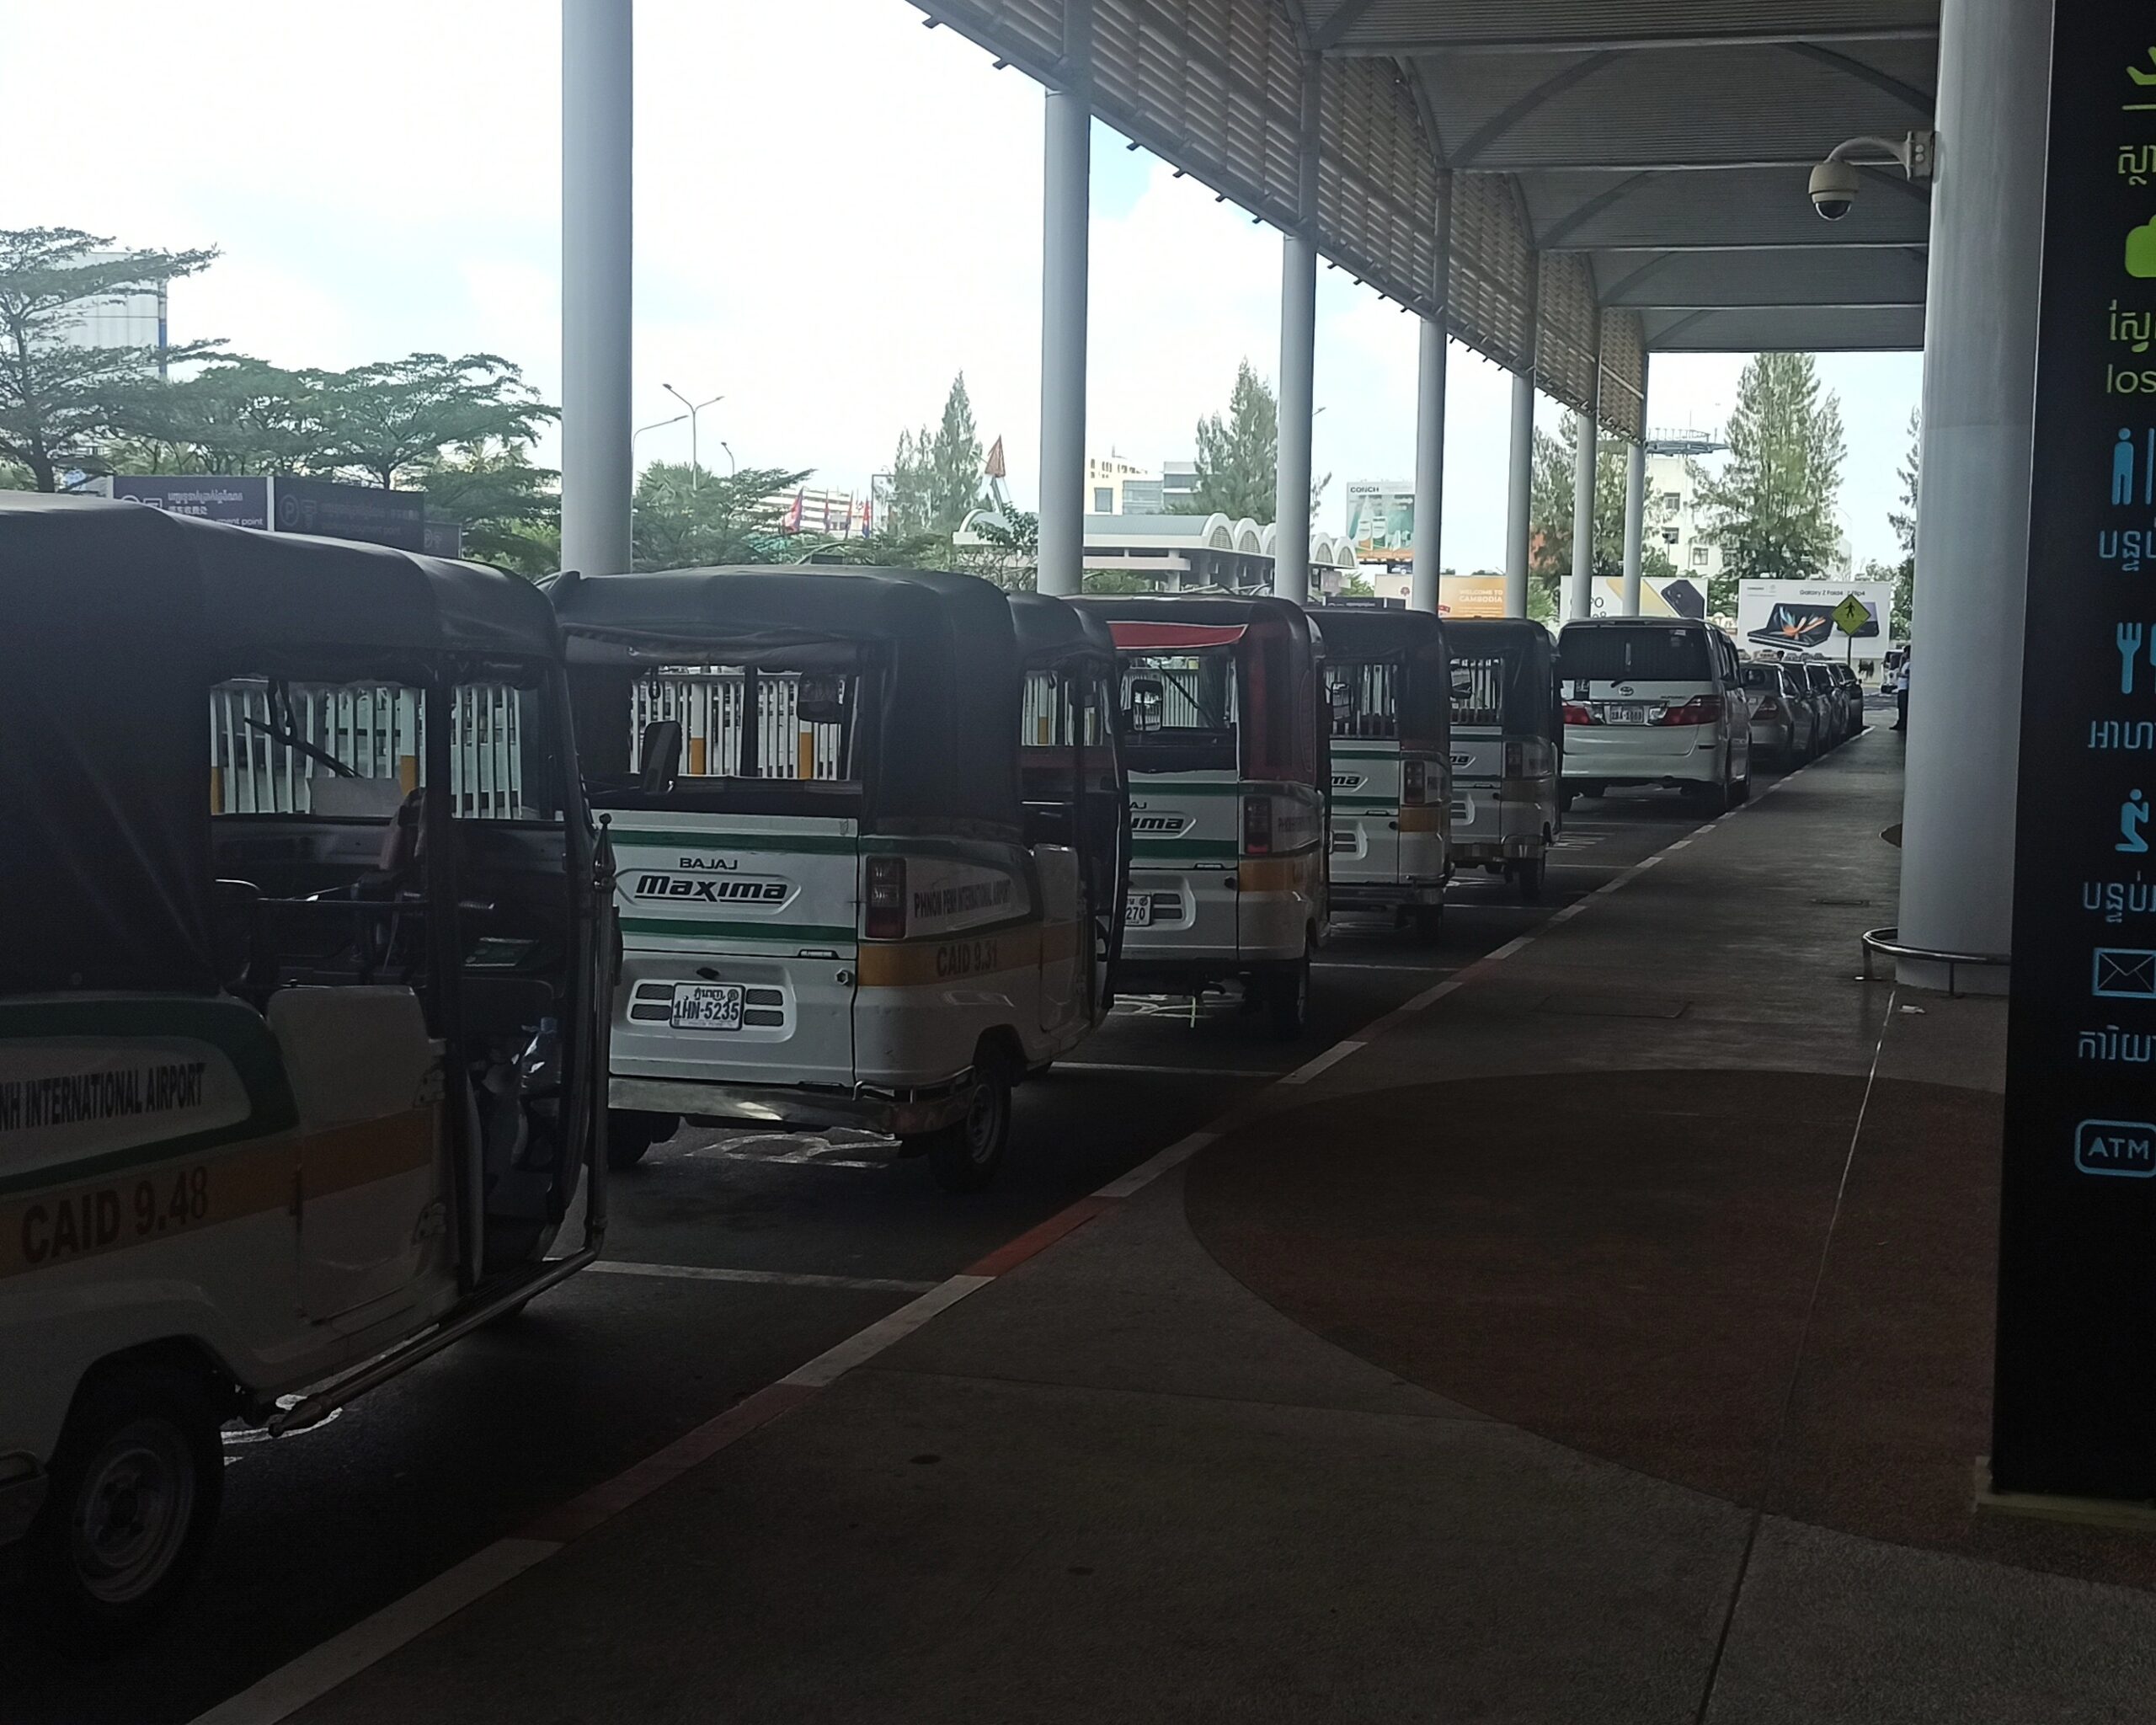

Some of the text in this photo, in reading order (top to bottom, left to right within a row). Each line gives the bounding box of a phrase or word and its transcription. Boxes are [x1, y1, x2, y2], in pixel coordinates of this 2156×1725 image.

[680, 857, 738, 870] BAJAJ
[937, 943, 969, 977] CAID
[25, 1069, 141, 1129] INTERNATIONAL
[146, 1062, 206, 1113] AIRPORT
[2088, 1137, 2149, 1161] ATM
[21, 1166, 209, 1263] CAID 9.48
